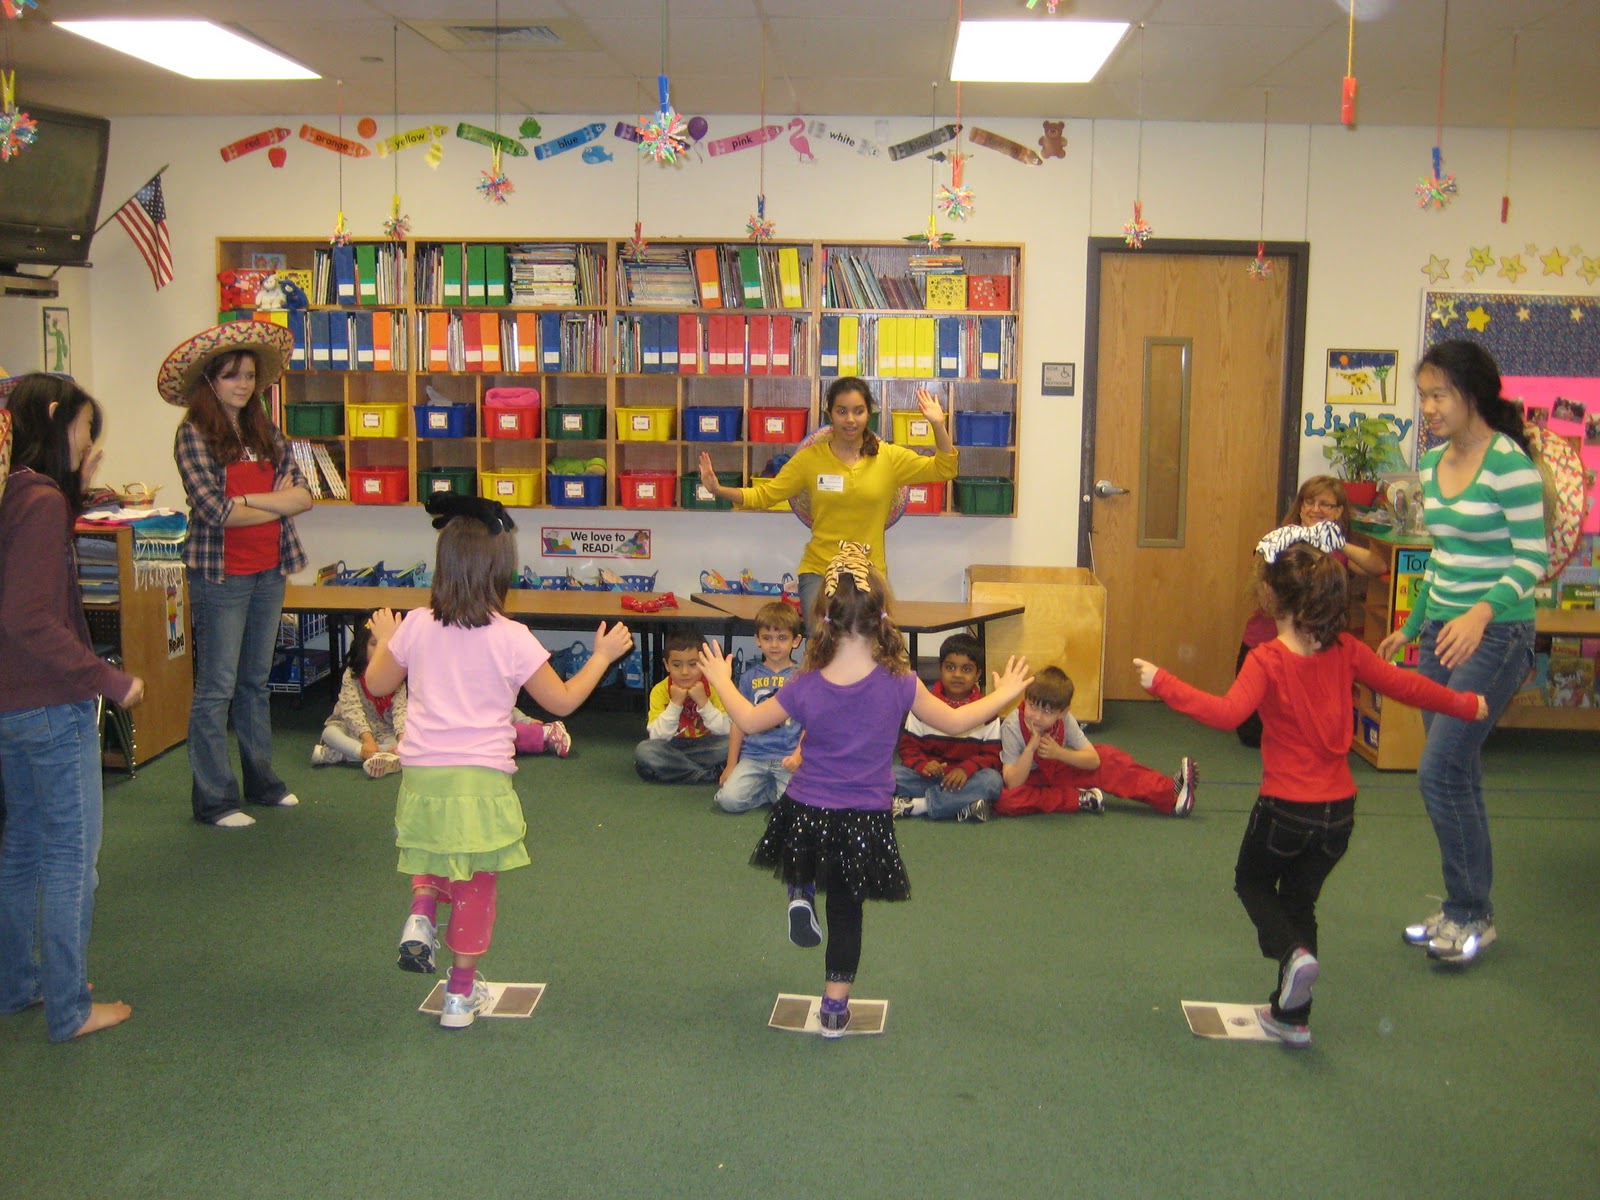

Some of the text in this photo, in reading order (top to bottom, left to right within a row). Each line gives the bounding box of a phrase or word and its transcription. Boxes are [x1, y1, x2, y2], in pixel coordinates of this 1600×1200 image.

[244, 136, 261, 149] red
[315, 133, 349, 151] orange
[395, 133, 425, 149] yellow
[557, 136, 578, 149] blue
[732, 136, 753, 150] pink
[829, 131, 856, 147] white
[570, 531, 625, 542] We love to
[582, 543, 614, 553] READ!
